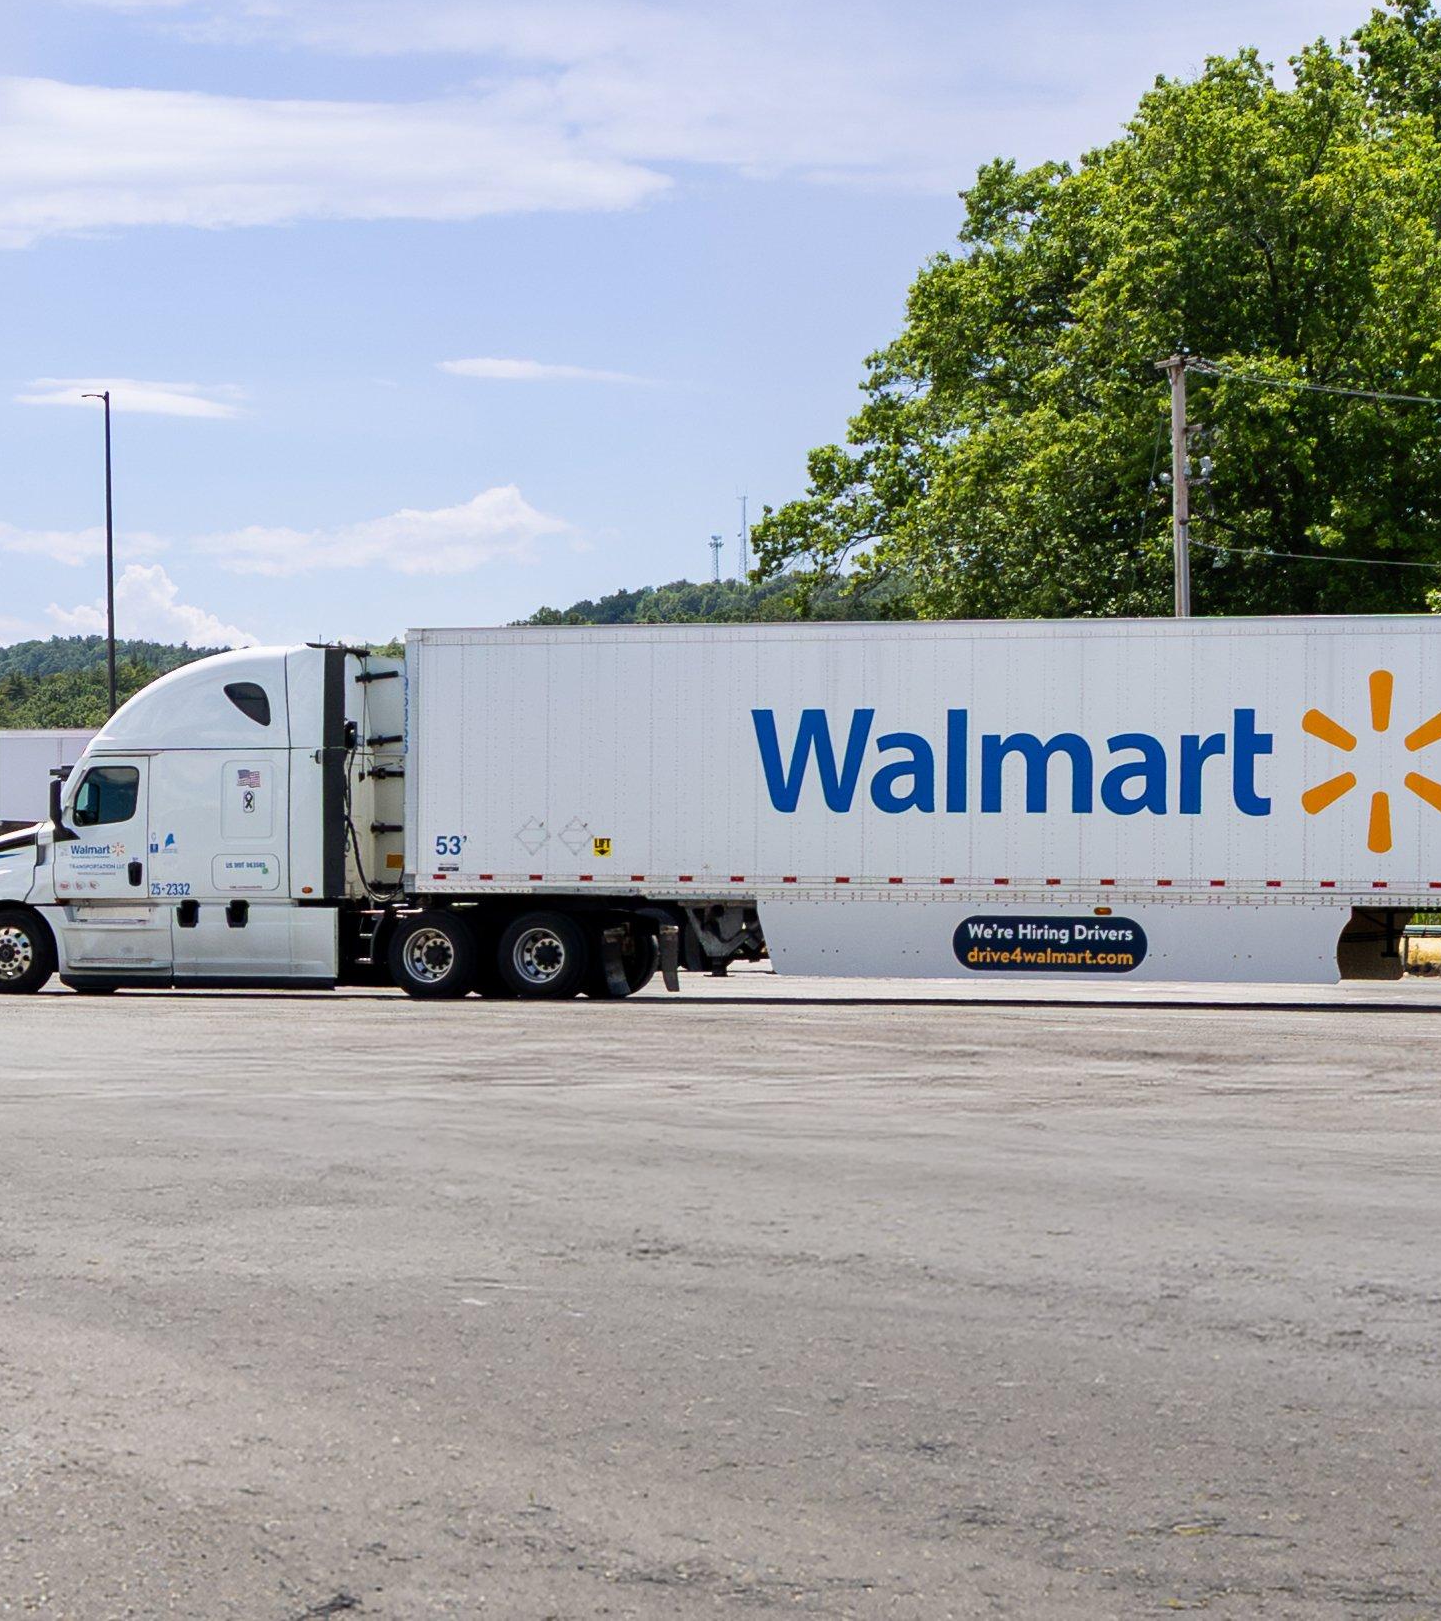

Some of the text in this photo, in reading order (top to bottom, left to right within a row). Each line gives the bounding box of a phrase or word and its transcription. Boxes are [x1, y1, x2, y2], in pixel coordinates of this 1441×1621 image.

[751, 708, 1273, 816] Walmart
[70, 844, 110, 855] Walmart
[151, 883, 190, 895] 25-2332
[968, 923, 1133, 944] We're Hiring Drivers
[967, 947, 1133, 965] drive4walmart.com
